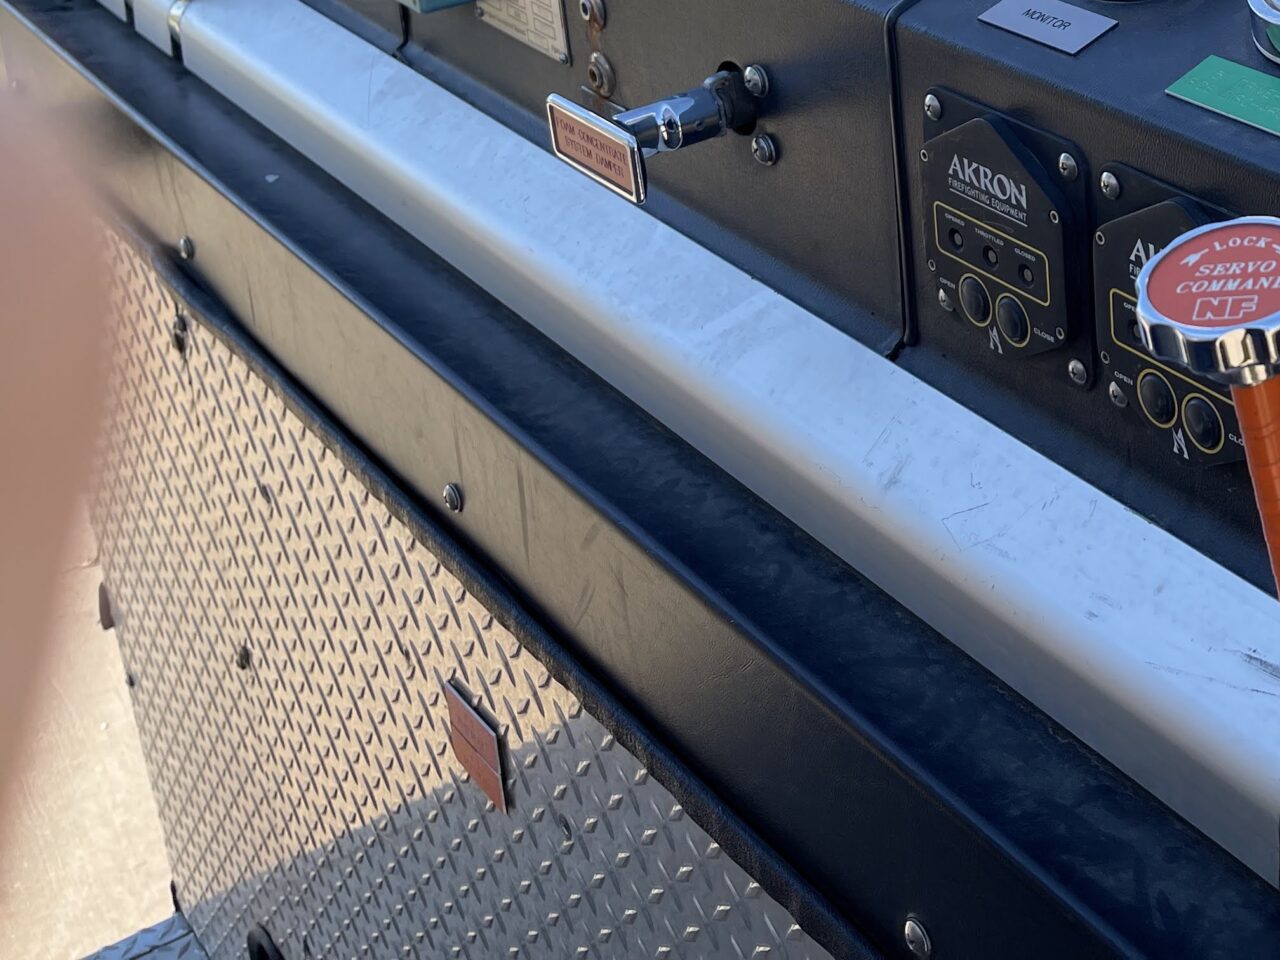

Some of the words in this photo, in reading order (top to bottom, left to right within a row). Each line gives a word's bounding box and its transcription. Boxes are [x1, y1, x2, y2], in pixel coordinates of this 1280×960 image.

[1021, 7, 1072, 32] MONITOR
[948, 153, 1027, 209] AKRON
[948, 178, 990, 204] FIREFIGHTING
[991, 198, 1027, 222] EQUIPMENT
[945, 212, 966, 226] OPENED
[975, 227, 1004, 246] THROTTLED
[1014, 247, 1036, 262] CLOSED
[1213, 236, 1272, 251] LOCK
[1195, 260, 1277, 277] SERVO
[939, 276, 957, 290] OPEN
[1192, 294, 1258, 321] NF
[1034, 327, 1055, 343] CLOSE
[1114, 370, 1134, 386] OPEN
[1228, 433, 1244, 446] CLO
